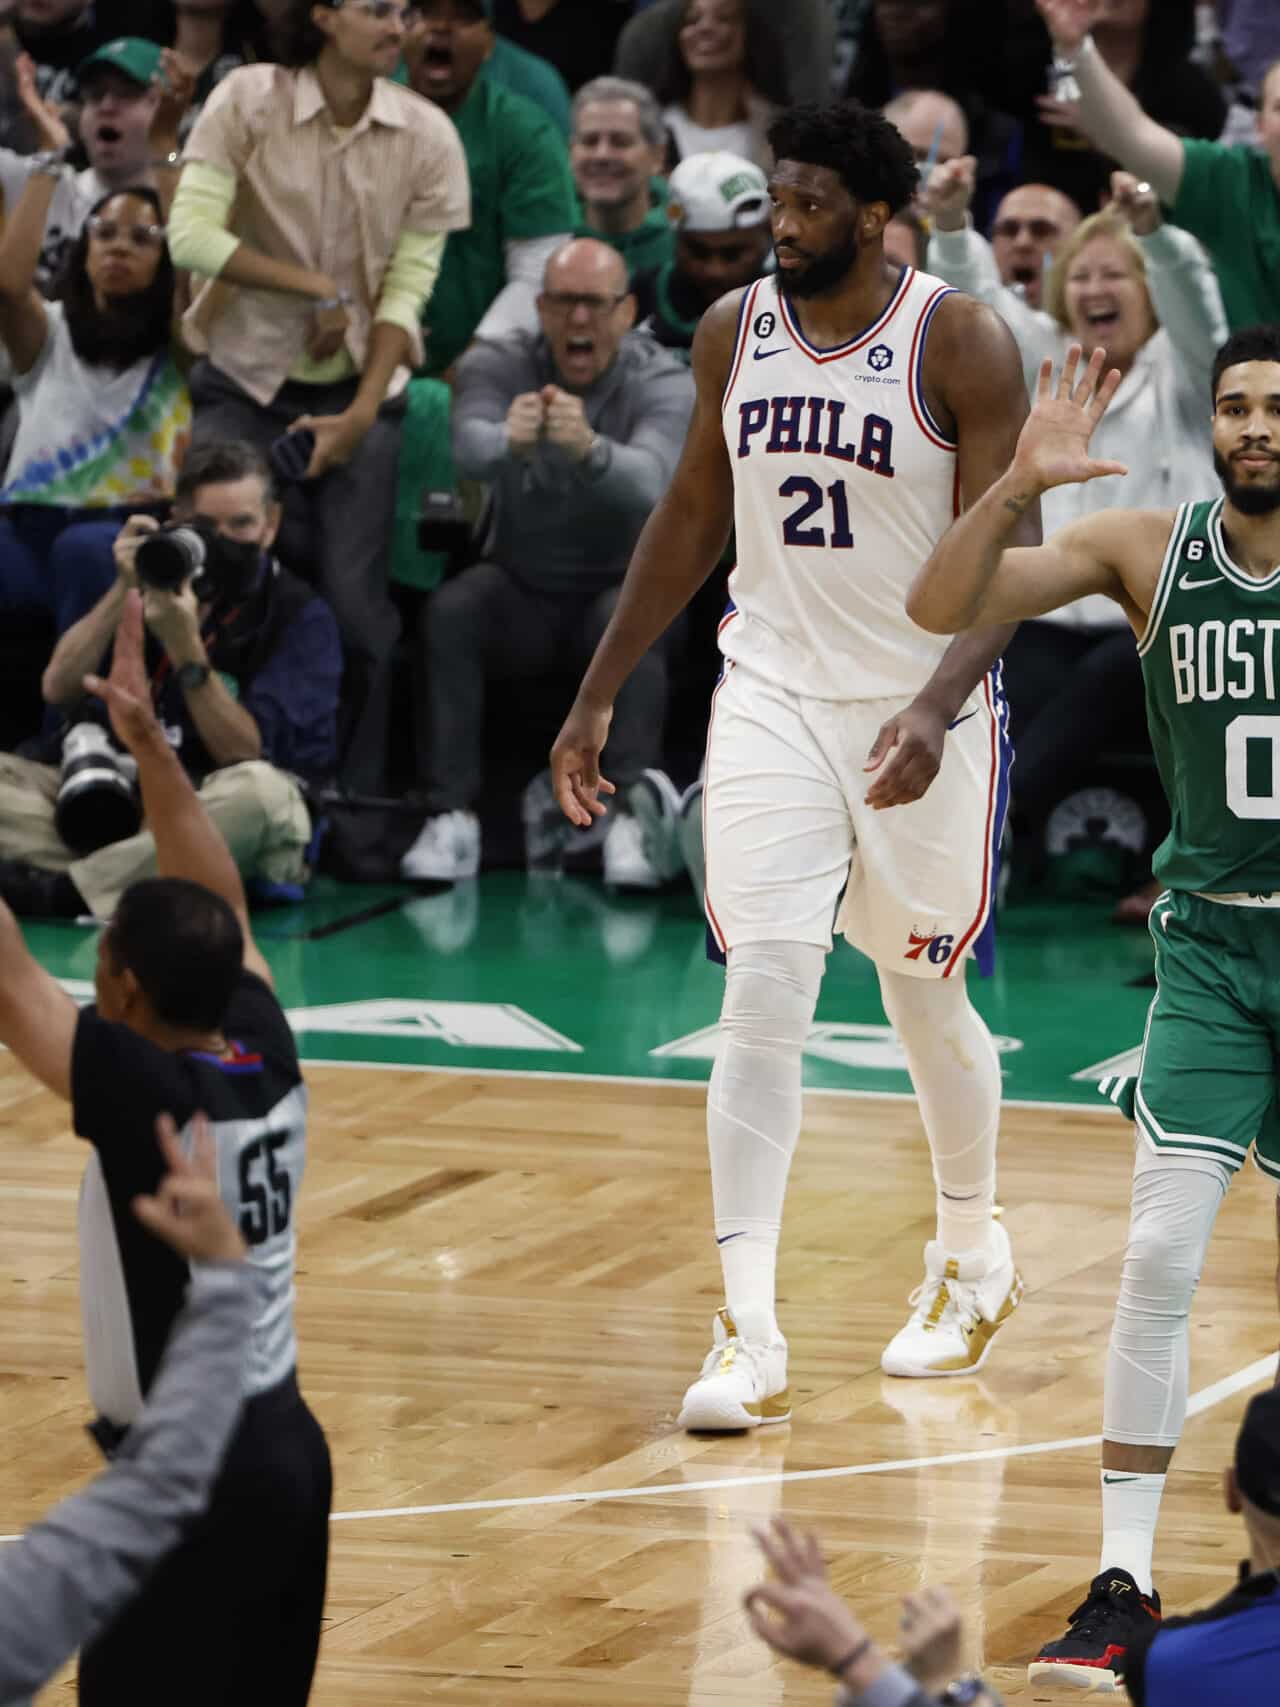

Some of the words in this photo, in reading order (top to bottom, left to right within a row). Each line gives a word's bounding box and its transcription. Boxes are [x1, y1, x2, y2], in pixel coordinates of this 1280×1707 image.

[758, 315, 773, 335] 6
[854, 373, 901, 387] crypto.com
[737, 396, 895, 478] PHILA
[779, 476, 854, 548] 21
[1187, 540, 1205, 560] 6
[904, 931, 954, 965] 76
[238, 1129, 291, 1246] 55
